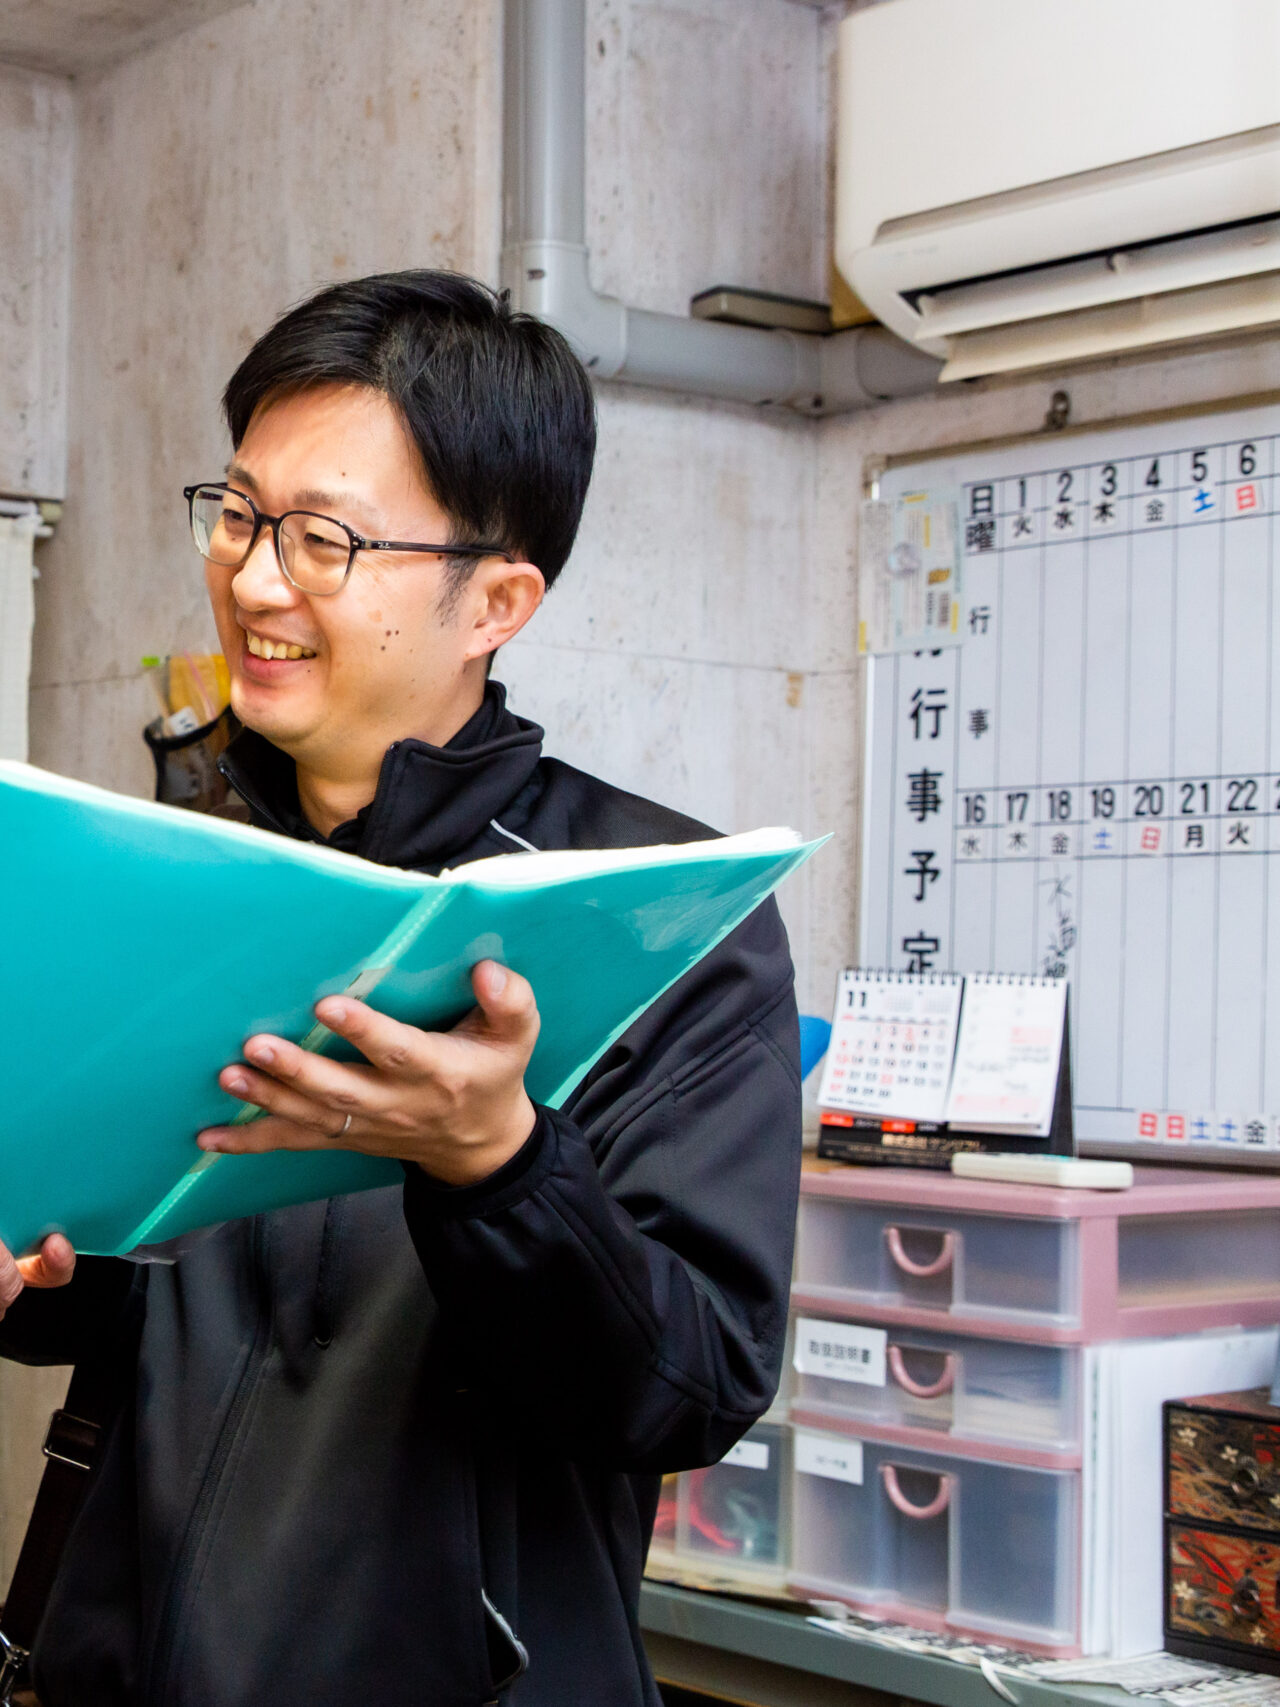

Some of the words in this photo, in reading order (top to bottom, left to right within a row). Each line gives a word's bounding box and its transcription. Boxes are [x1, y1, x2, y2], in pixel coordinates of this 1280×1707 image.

[971, 485, 993, 515] 日
[1018, 480, 1027, 508] 1
[1057, 470, 1074, 503] 2
[1101, 465, 1117, 497] 3
[1145, 458, 1163, 488] 4
[1192, 451, 1208, 483] 5
[1239, 444, 1256, 476] 6
[966, 519, 996, 553] 曜
[1013, 517, 1032, 538] 火
[1054, 507, 1075, 530] 水
[1093, 499, 1116, 524] 木
[1145, 499, 1165, 523] 金
[1194, 488, 1215, 514] 土
[1236, 485, 1256, 510] 日
[964, 793, 987, 824] 16
[1006, 792, 1030, 823] 17
[1047, 789, 1072, 820] 18
[1090, 787, 1116, 819] 19
[1133, 785, 1164, 817] 20
[1180, 782, 1210, 814] 21
[1227, 780, 1257, 811] 22
[961, 833, 982, 856] 水
[1008, 831, 1028, 852] 木
[1050, 832, 1070, 856] 金
[1093, 827, 1113, 851] 土
[1140, 826, 1162, 851] 日
[1184, 825, 1204, 848] 月
[1228, 821, 1249, 845] 火
[847, 990, 867, 1008] 11
[1139, 1113, 1158, 1138] 日
[1166, 1114, 1186, 1140] 日
[1190, 1115, 1211, 1140] 土
[1216, 1117, 1238, 1143] 土
[1244, 1119, 1267, 1145] 金
